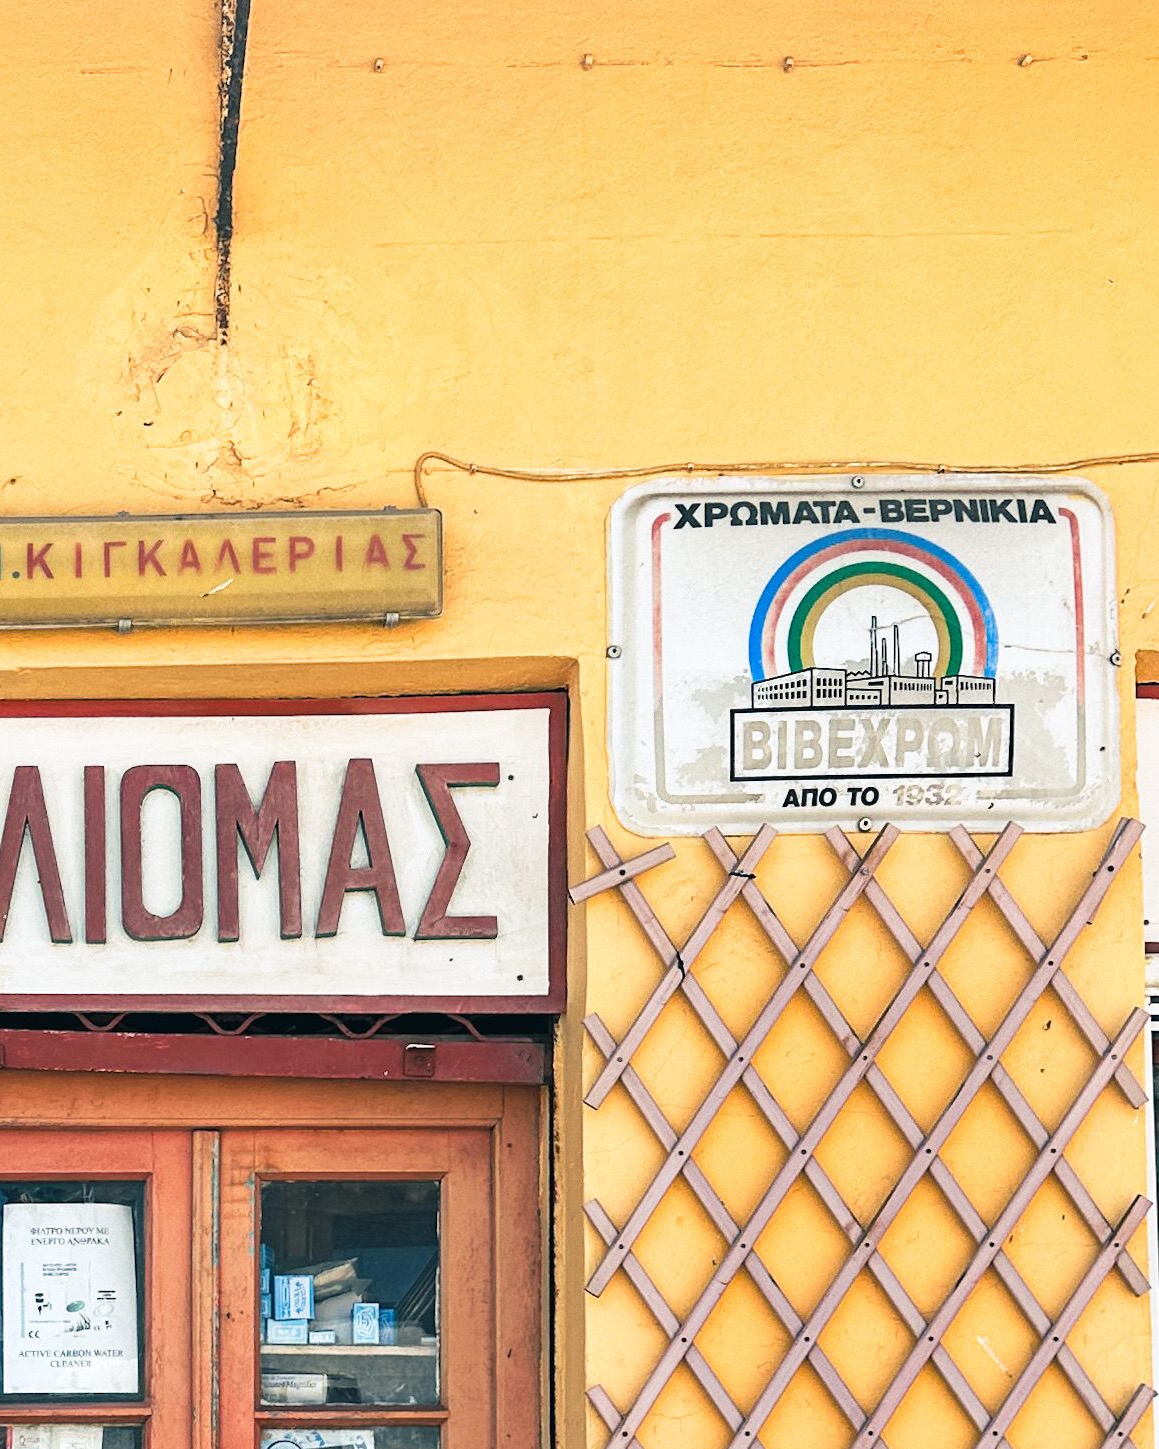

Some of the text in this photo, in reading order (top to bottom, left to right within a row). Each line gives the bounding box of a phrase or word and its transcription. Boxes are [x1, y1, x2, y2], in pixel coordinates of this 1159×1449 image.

[742, 715, 1002, 770] ΒΙΒΕΧΡΩΜ
[782, 784, 963, 807] ΑΠΟ ΤΟ 1932
[19, 1349, 123, 1358] ACTIVE CARBON WATER
[50, 1360, 91, 1368] CLEANER
